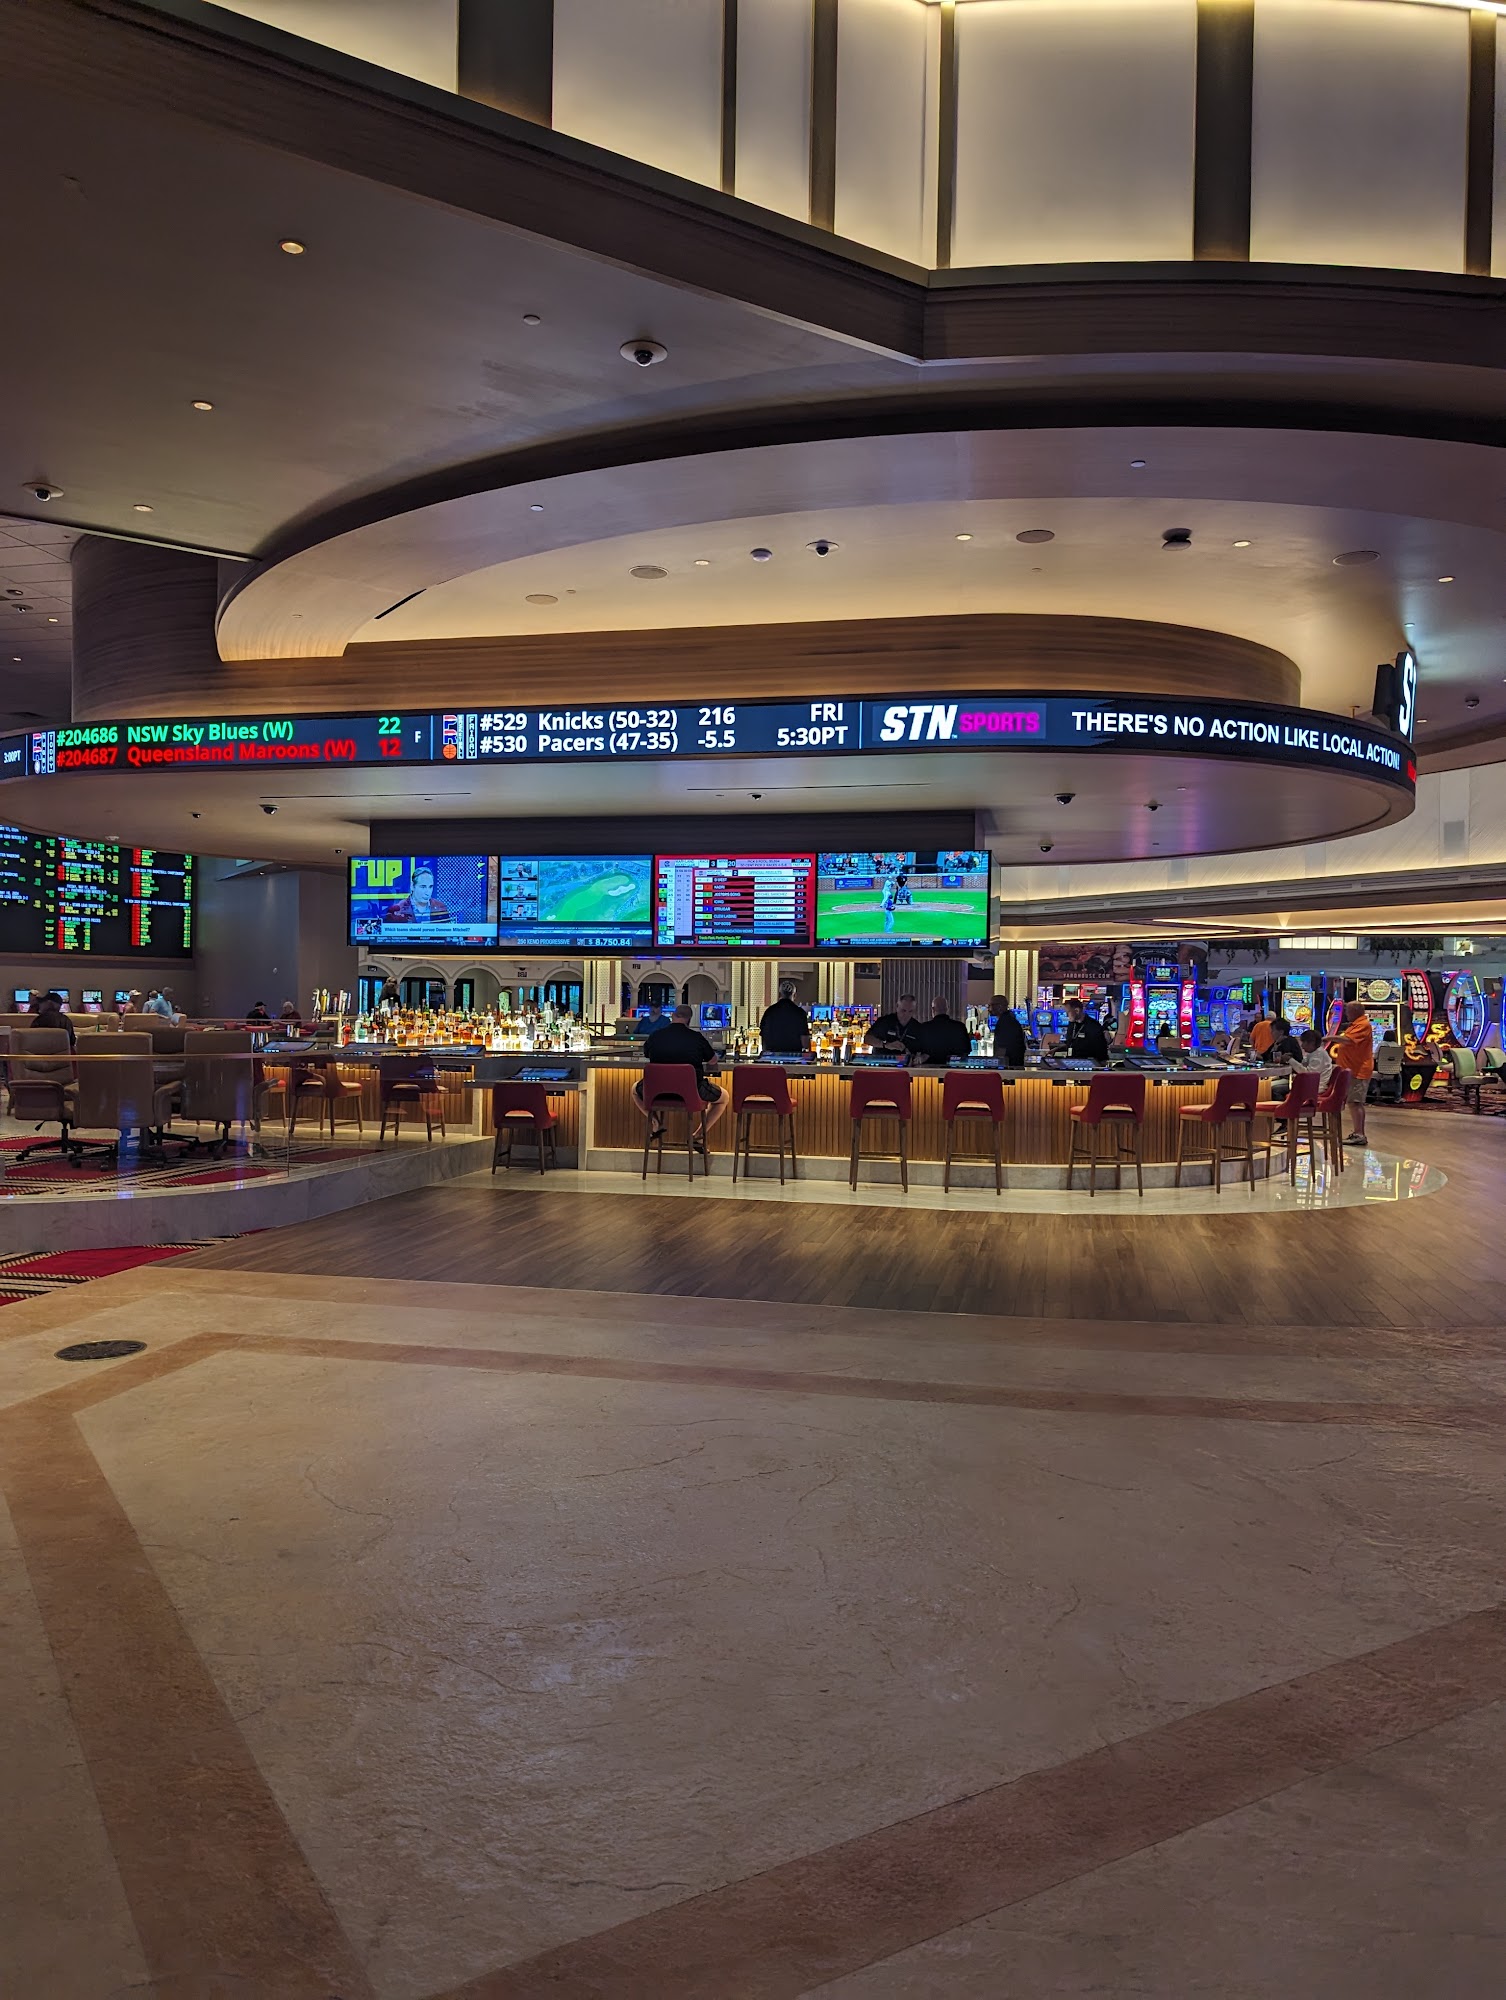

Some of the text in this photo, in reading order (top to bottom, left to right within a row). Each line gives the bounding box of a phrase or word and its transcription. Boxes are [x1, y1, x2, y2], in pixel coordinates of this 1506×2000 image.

[479, 706, 736, 734] #529 Knicks (50-32) 216
[810, 702, 844, 722] FRI
[879, 704, 1040, 742] STN SPORTS
[56, 720, 294, 747] #204686 NSW Sky Blues (W)
[378, 716, 402, 735] 22
[414, 730, 422, 744] F
[777, 725, 849, 747] 5:30PT
[56, 738, 357, 767] #204687 Queensland Maroons (W)
[379, 737, 401, 757] 12
[479, 729, 736, 755] #530 Pacers (47-35) -5.5
[1071, 711, 1401, 770] THERE'S NO ACTION LIKE LOCAL ACTION!
